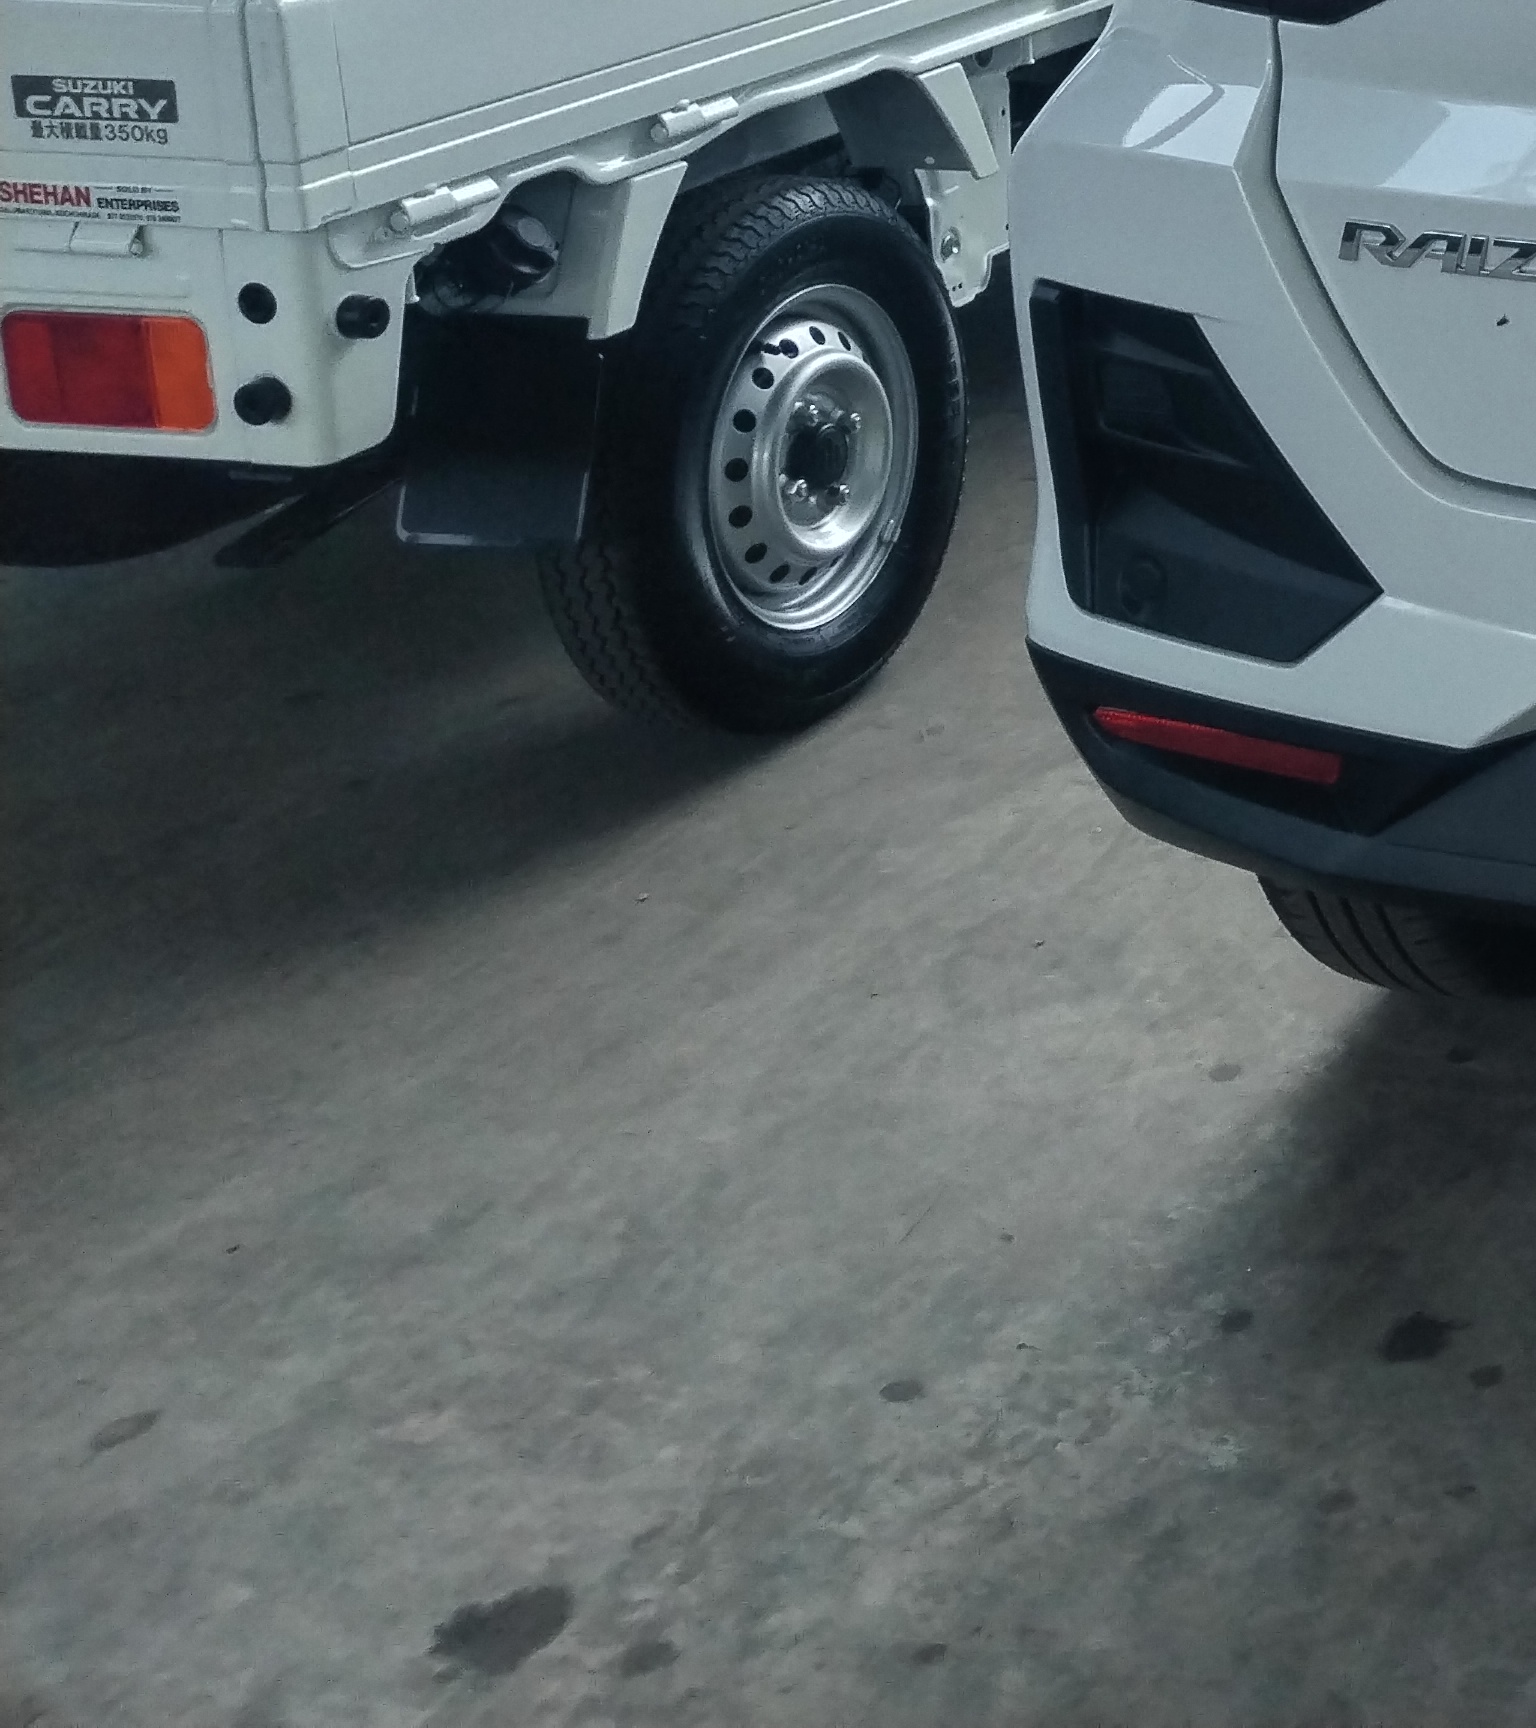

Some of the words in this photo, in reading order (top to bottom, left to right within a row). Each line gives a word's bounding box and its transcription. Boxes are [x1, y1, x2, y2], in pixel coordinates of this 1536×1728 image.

[51, 78, 135, 95] SUZUKI
[25, 95, 168, 120] CARRY
[0, 180, 92, 208] SHEHAN
[97, 197, 180, 213] ENTERPRISES
